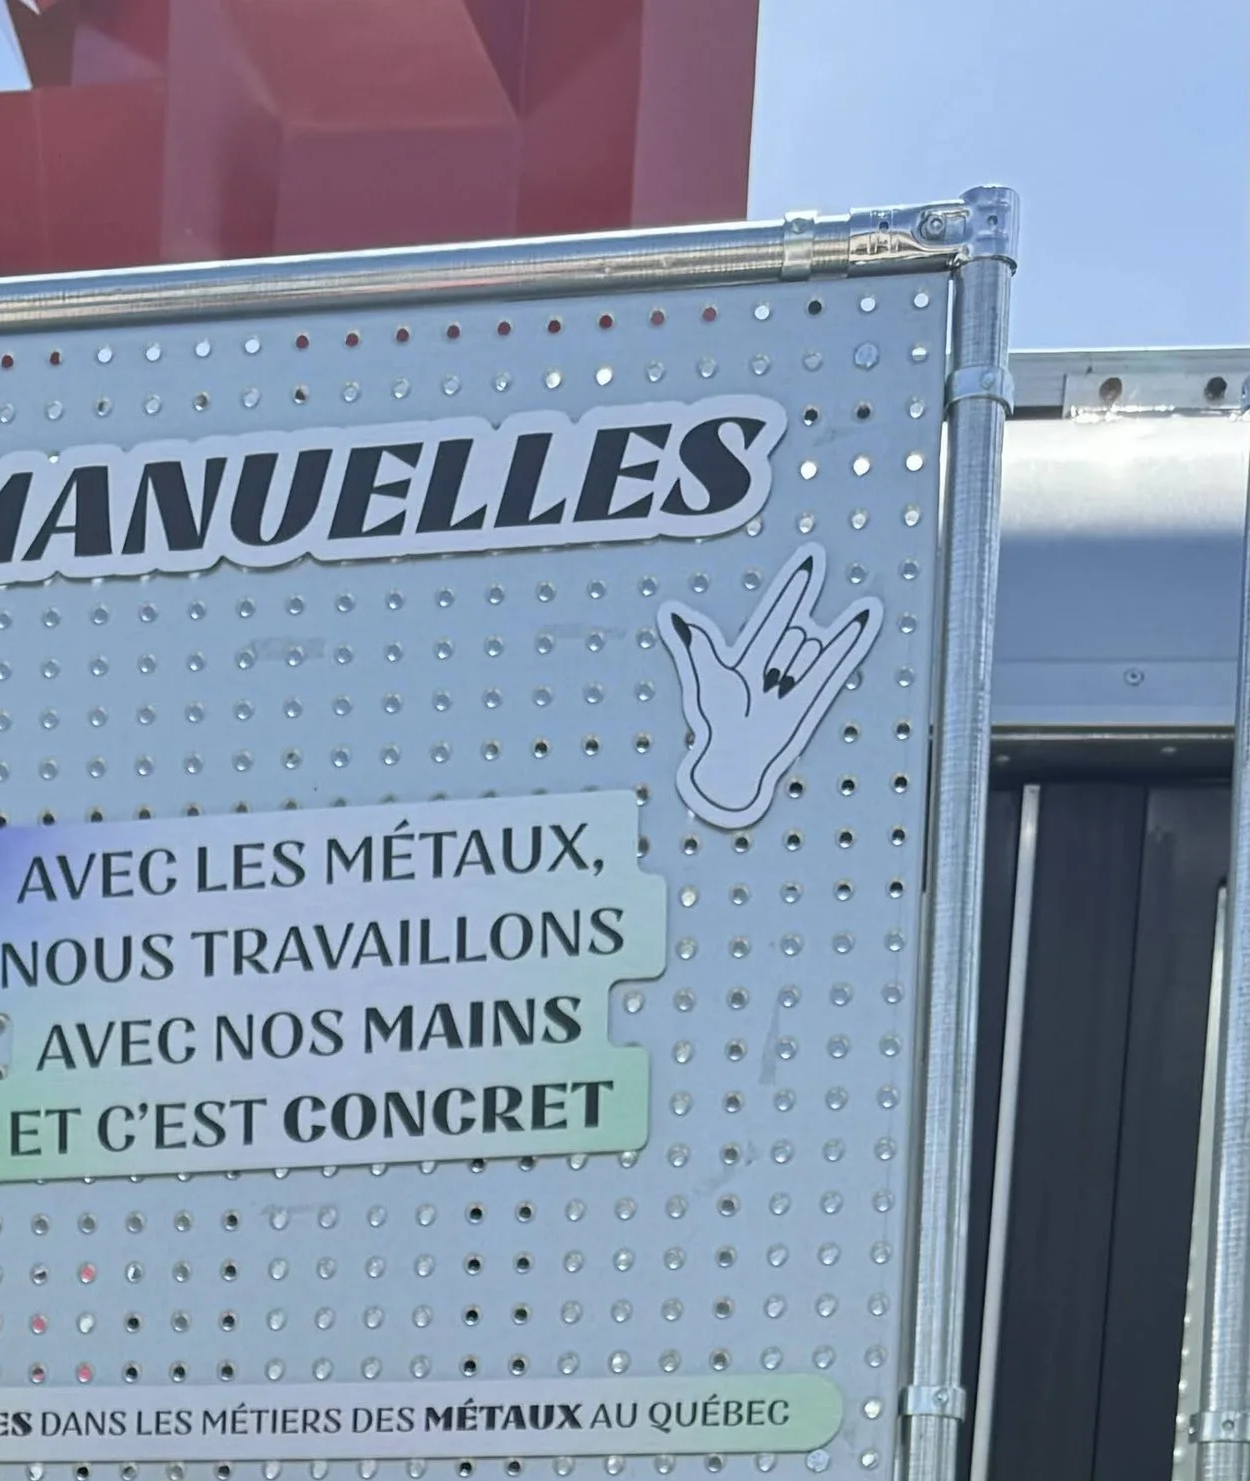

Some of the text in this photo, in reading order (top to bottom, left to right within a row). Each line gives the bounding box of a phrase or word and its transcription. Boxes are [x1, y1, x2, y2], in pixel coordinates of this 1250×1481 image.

[17, 821, 604, 903] AVEC LES MÉTAUX,
[1, 907, 625, 989] NOUS TRAVAILLONS
[37, 996, 582, 1072] AVEC NOS MAINS
[10, 1080, 614, 1157] ET C'EST CONCRET
[41, 1410, 127, 1436] DANS
[136, 1410, 193, 1436] LES
[201, 1403, 342, 1436] MÉTIERS
[351, 1407, 415, 1434] DES
[424, 1398, 583, 1432] MÉTAUX
[589, 1403, 638, 1429] AU
[648, 1394, 791, 1435] QUÉBEC
